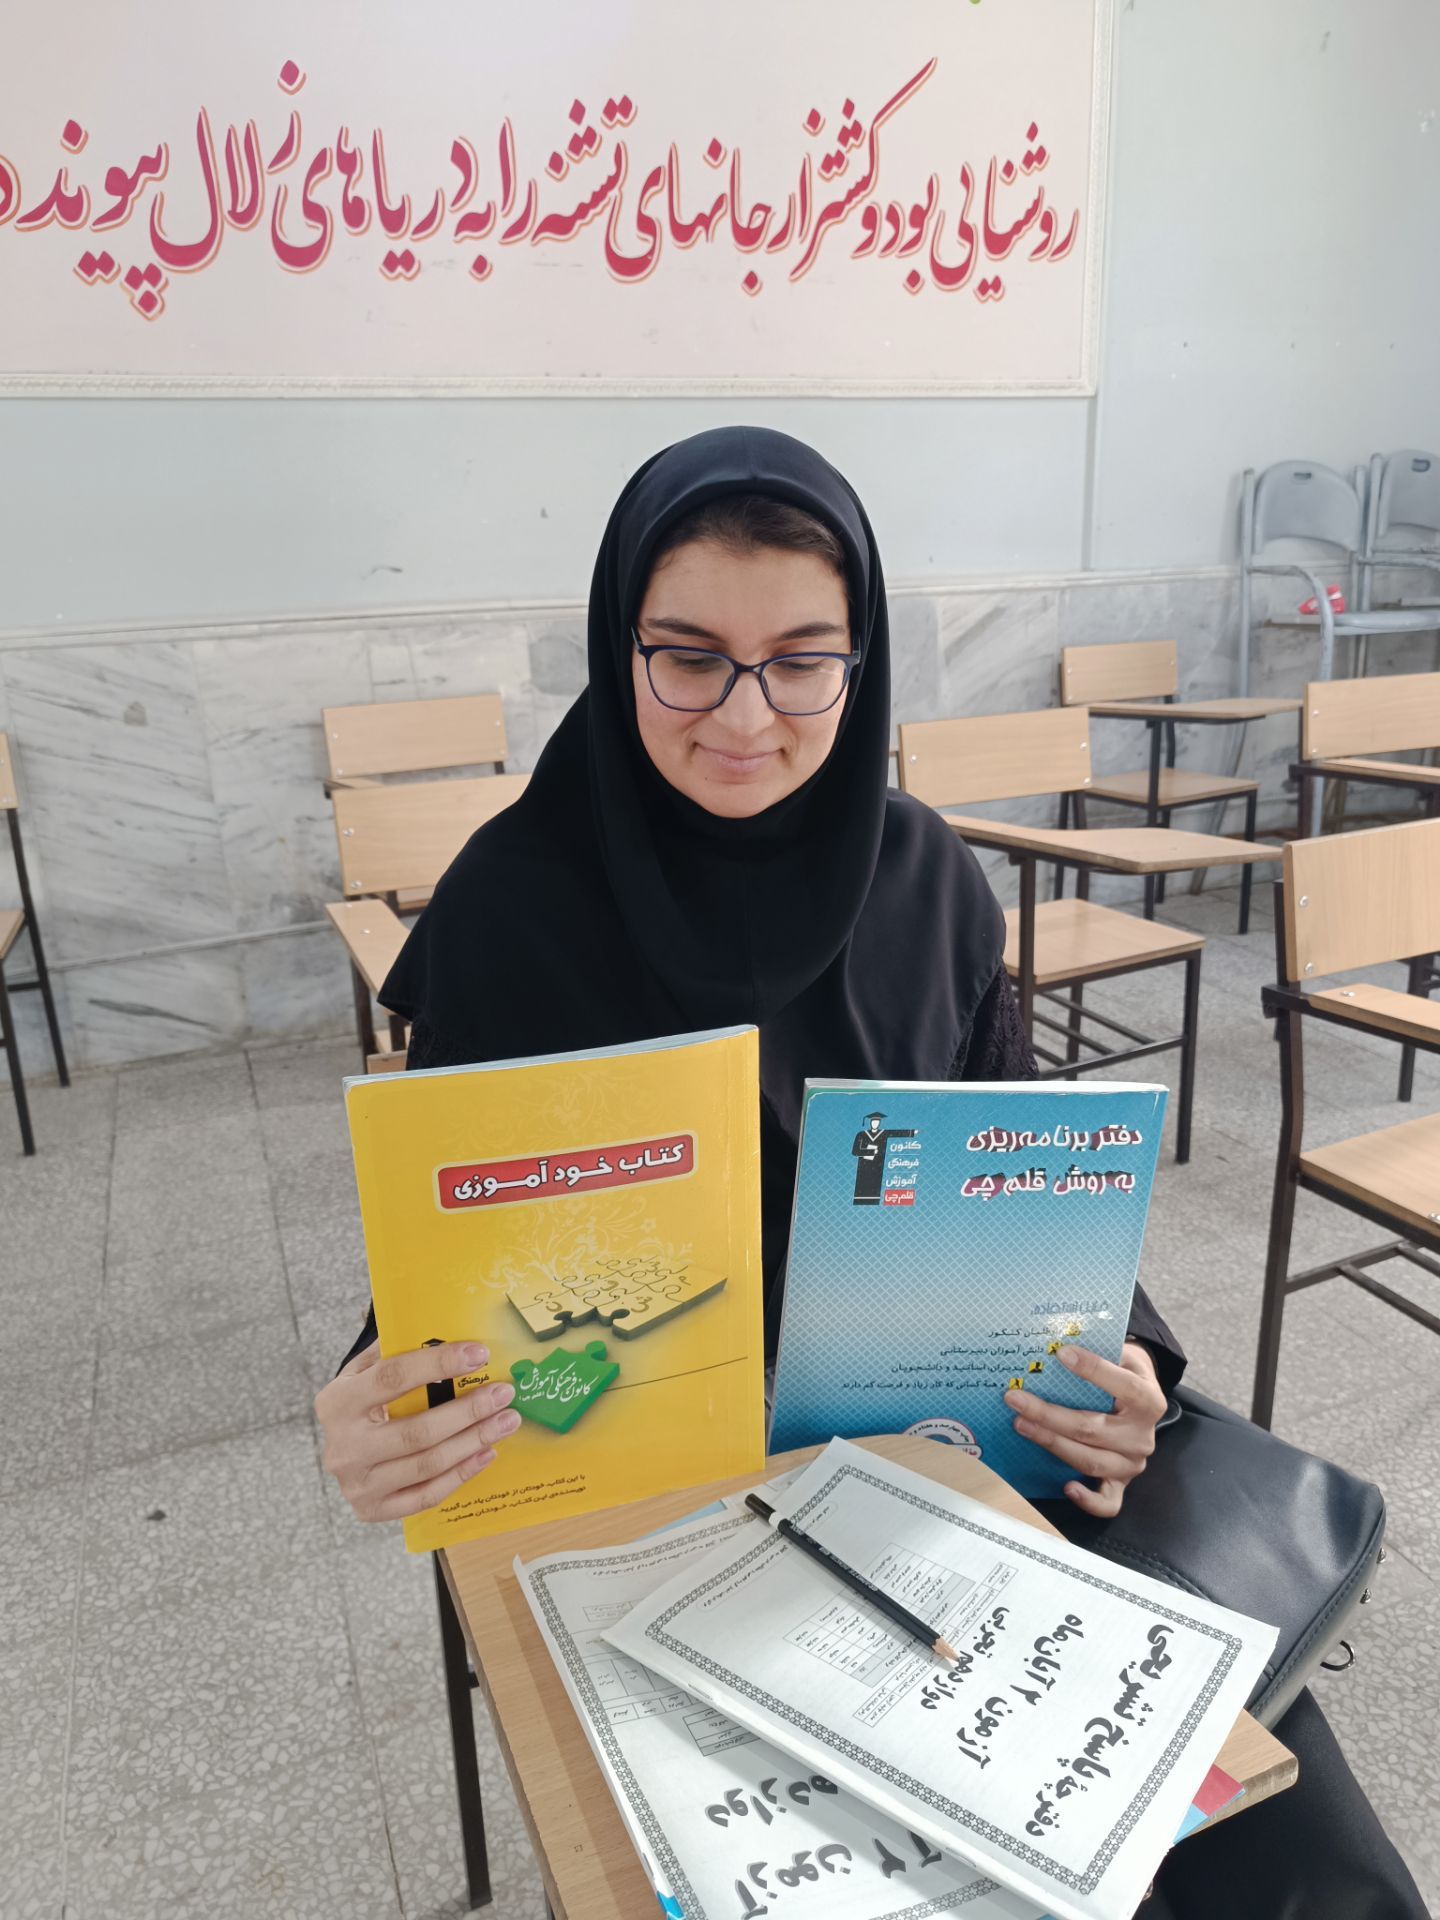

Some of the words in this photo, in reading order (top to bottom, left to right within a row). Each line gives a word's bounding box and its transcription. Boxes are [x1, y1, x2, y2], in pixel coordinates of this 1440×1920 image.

[149, 59, 307, 273] زلال
[499, 115, 538, 246] را
[531, 94, 638, 246] تشنه
[766, 56, 938, 281] کشتزار
[14, 117, 170, 321] پیوند
[851, 200, 880, 258] و
[879, 171, 939, 294] بود
[928, 121, 1079, 303] روشنایی
[454, 200, 496, 281] به
[889, 1140, 922, 1152] کانون
[1096, 1124, 1143, 1151] دفتر
[553, 1157, 613, 1187] خود
[618, 1143, 685, 1175] کتاب
[887, 1157, 919, 1169] فرهنگی
[453, 1160, 549, 1201] آموزی
[885, 1174, 918, 1187] آموزش
[961, 1175, 996, 1201] چی
[1003, 1170, 1046, 1197] قلم
[1053, 1165, 1107, 1196] روش
[1114, 1173, 1136, 1194] به
[989, 1344, 1021, 1356] آموزان
[457, 1374, 490, 1389] فرهنگی
[519, 1367, 560, 1392] آموزش
[546, 1361, 577, 1400] فرهنگی
[921, 1649, 974, 1709] دوازدهم
[972, 1606, 1011, 1659] تجربی
[1057, 1717, 1129, 1778] پاسخ
[1114, 1625, 1174, 1726] تشریحی
[957, 1697, 1013, 1769] آزمون
[1009, 1684, 1043, 1707] ۲
[704, 1775, 839, 1828] دوازده
[734, 1843, 852, 1920] آزمون
[871, 1837, 908, 1880] ۲
